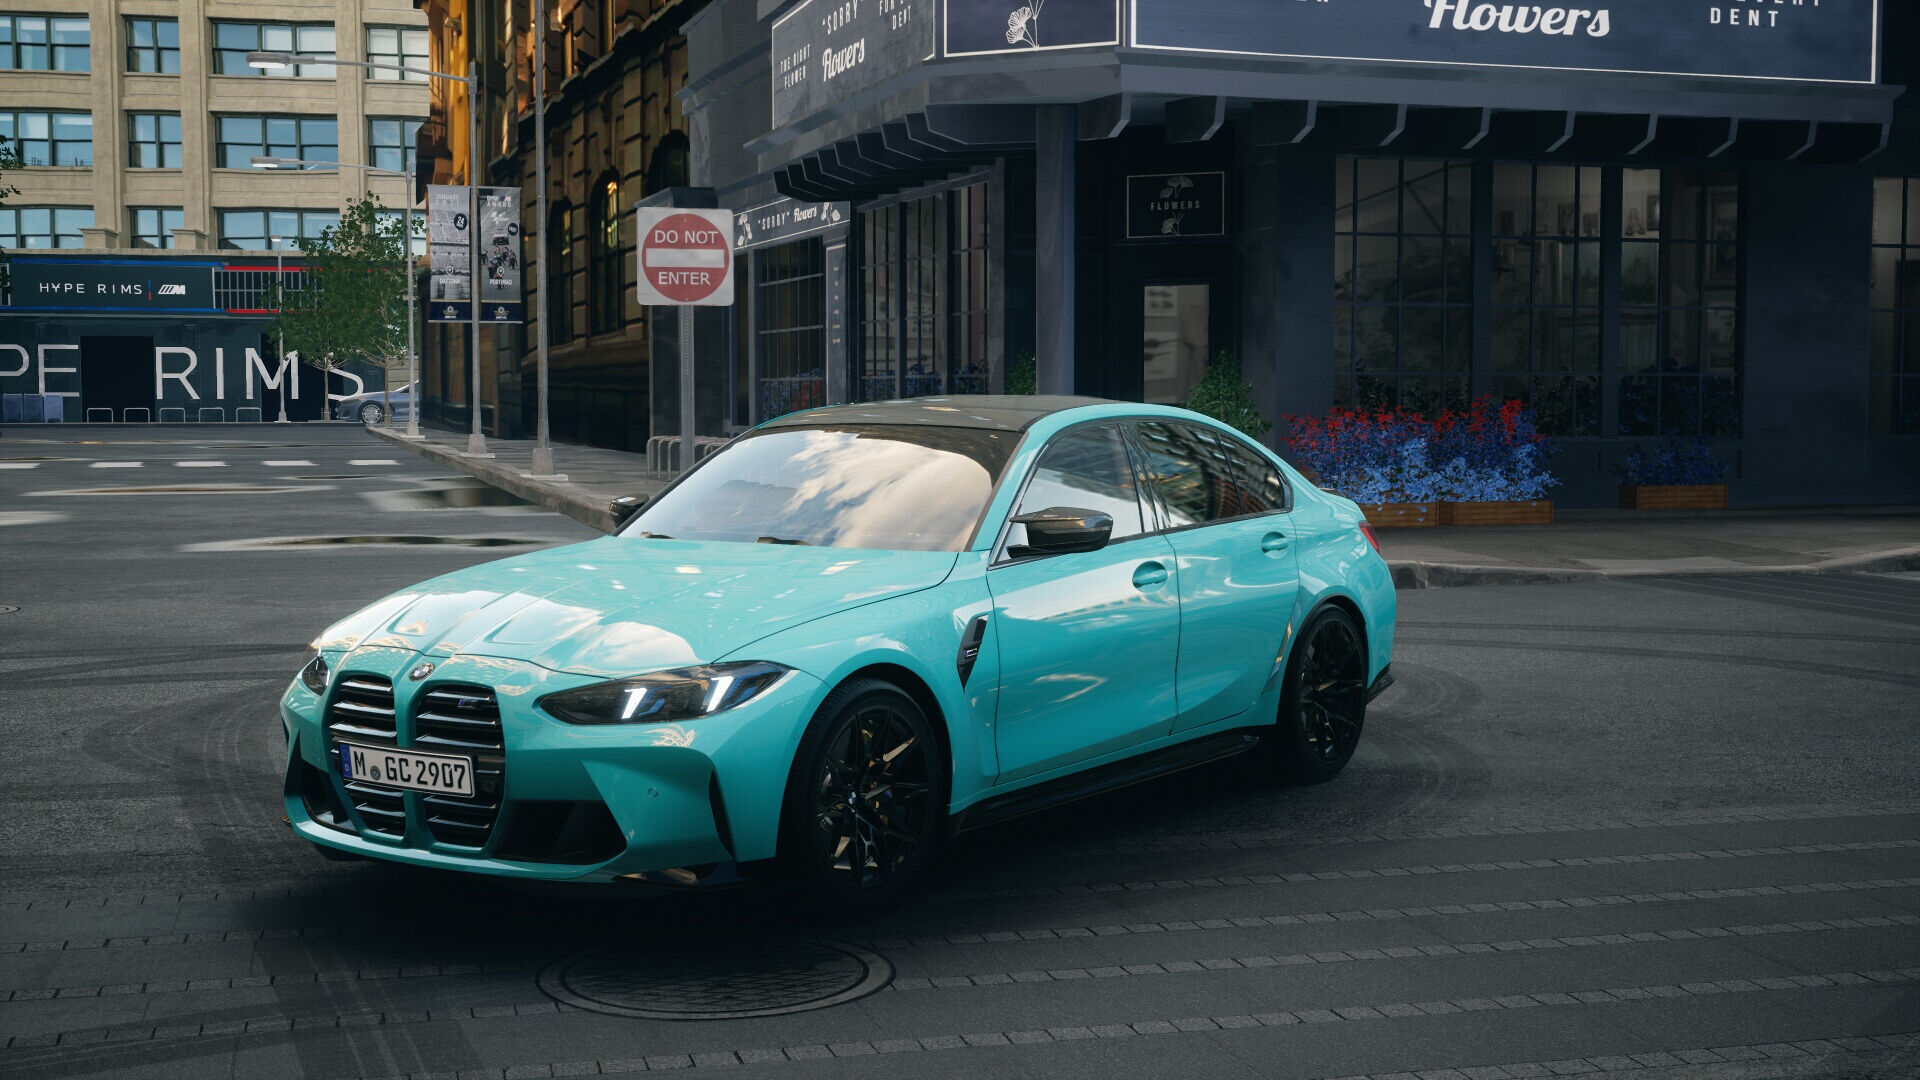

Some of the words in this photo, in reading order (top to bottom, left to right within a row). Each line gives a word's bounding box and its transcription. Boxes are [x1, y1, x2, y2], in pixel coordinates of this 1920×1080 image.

[822, 0, 864, 35] "SORRY
[892, 5, 911, 31] DENT
[1424, 0, 1610, 38] Flowers
[1710, 7, 1779, 27] DENT
[780, 56, 791, 74] THE
[793, 43, 810, 66] RIGHT
[822, 37, 865, 82] Flowers
[784, 65, 806, 90] FLOWER
[1150, 200, 1201, 211] FLOWERS
[654, 230, 678, 244] DO
[684, 230, 718, 244] NOT
[39, 282, 85, 294] HYPE
[97, 283, 143, 295] RIMS
[658, 271, 711, 285] ENTER
[353, 750, 367, 777] M
[384, 755, 412, 783] GC
[415, 760, 466, 789] 2907
